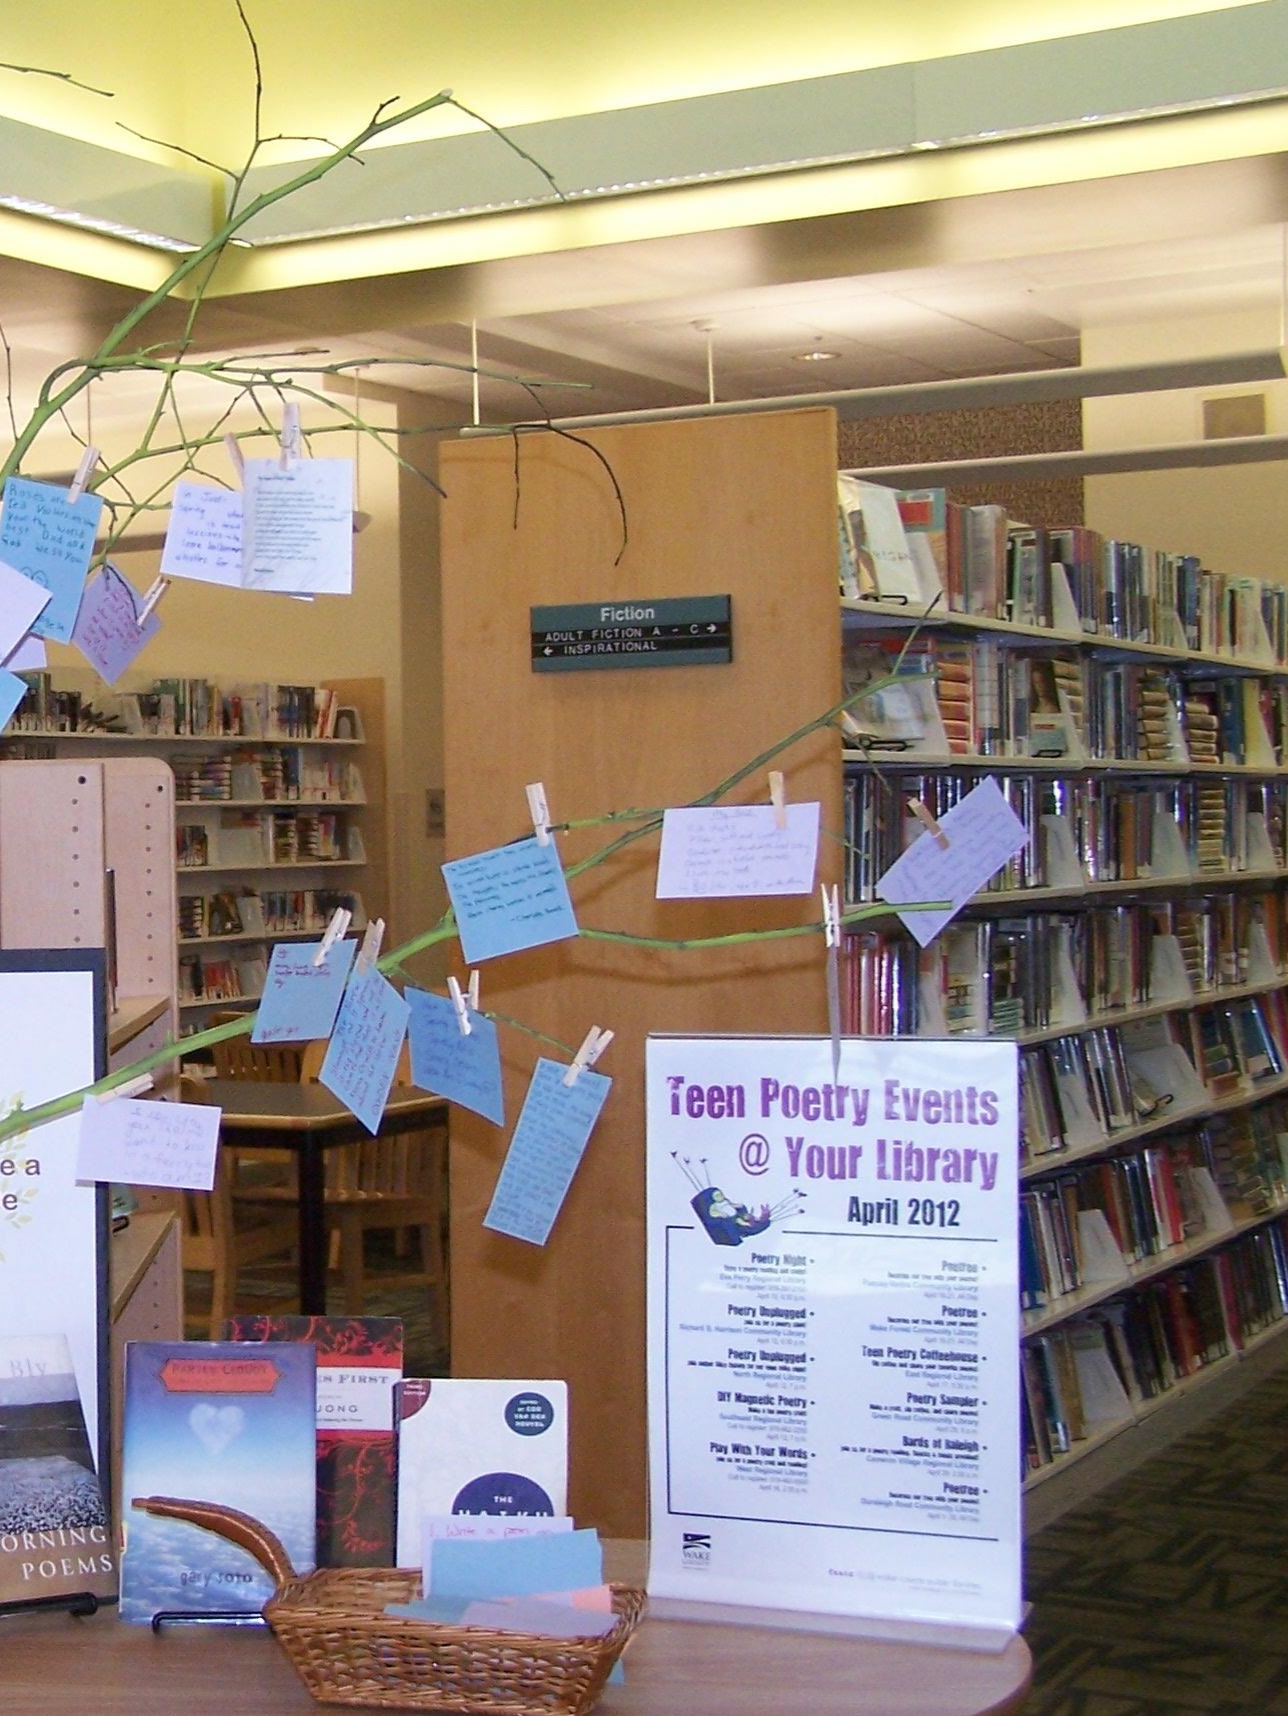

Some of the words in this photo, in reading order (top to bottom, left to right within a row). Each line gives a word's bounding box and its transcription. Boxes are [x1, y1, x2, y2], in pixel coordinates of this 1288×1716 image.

[600, 607, 655, 622] Fiction
[545, 631, 583, 642] ADULT
[592, 629, 642, 640] FICTION
[652, 626, 661, 636] A
[690, 624, 699, 634] C
[564, 641, 657, 656] INSPIRATIONAL
[667, 1076, 746, 1118] Teen
[761, 1077, 870, 1127] Poetry
[884, 1079, 999, 1126] Events
[25, 1158, 41, 1177] a
[739, 1133, 770, 1176] @
[785, 1136, 863, 1180] Your
[877, 1139, 999, 1191] Library
[848, 1196, 898, 1227] April
[908, 1198, 961, 1228] 2012
[752, 1252, 780, 1265] Poetry
[783, 1254, 806, 1266] Night
[728, 1304, 756, 1317] Poetry
[759, 1305, 806, 1319] Unplugged
[942, 1305, 978, 1318] Poetree
[728, 1348, 756, 1362] Poetry
[759, 1350, 806, 1364] Unplugged
[862, 1345, 884, 1357] Teen
[887, 1347, 916, 1360] Poetry
[920, 1348, 978, 1363] Coffeehouse
[10, 1358, 48, 1378] Bly
[339, 1374, 389, 1384] FIRST
[717, 1391, 731, 1402] DIY
[735, 1392, 775, 1405] Magnetic
[778, 1395, 807, 1409] Poetry
[907, 1392, 936, 1406] Poetry
[940, 1394, 978, 1407] Sampler
[710, 1442, 728, 1455] Play
[731, 1443, 752, 1455] With
[755, 1445, 775, 1457] Your
[778, 1446, 807, 1460] Words
[902, 1435, 929, 1448] Bards
[932, 1438, 942, 1449] of
[945, 1439, 979, 1452] Raleigh
[943, 1482, 979, 1496] Poetree
[22, 1554, 113, 1580] POEMS
[180, 1572, 212, 1588] gary
